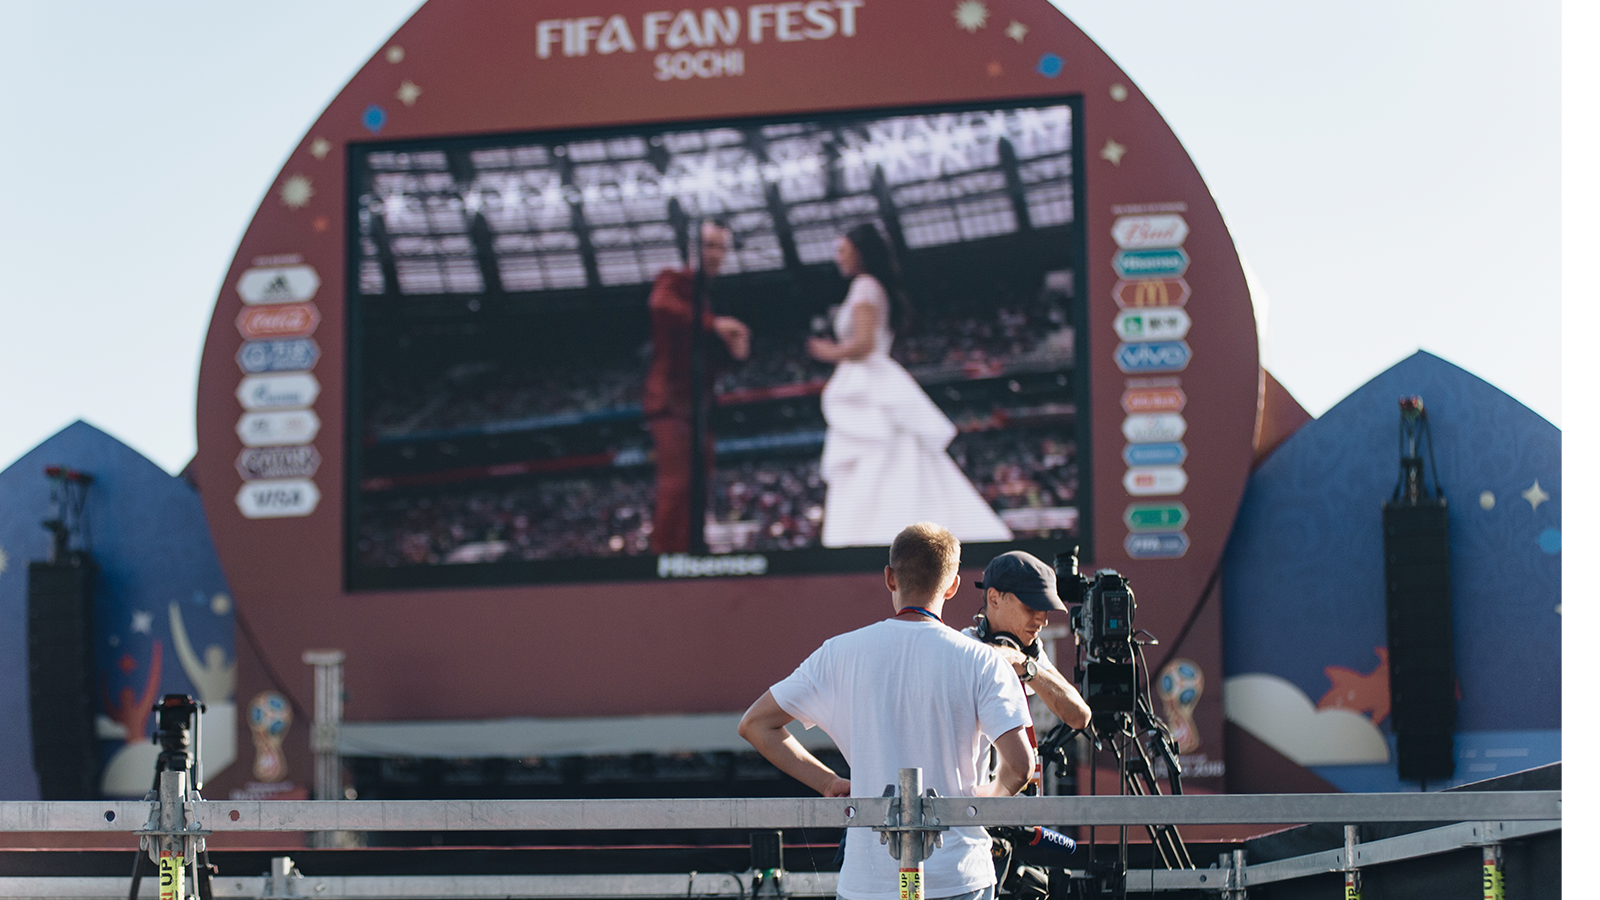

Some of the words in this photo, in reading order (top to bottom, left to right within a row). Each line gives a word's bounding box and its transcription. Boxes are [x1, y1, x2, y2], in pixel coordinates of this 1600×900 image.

[535, 15, 636, 59] FIFA
[642, 6, 742, 50] FAN
[748, 0, 865, 44] FEST
[654, 49, 745, 81] SOCHI
[657, 553, 768, 578] Hisense
[1042, 829, 1074, 849] РОССИЯ
[161, 859, 173, 886] UP
[901, 873, 908, 888] UP
